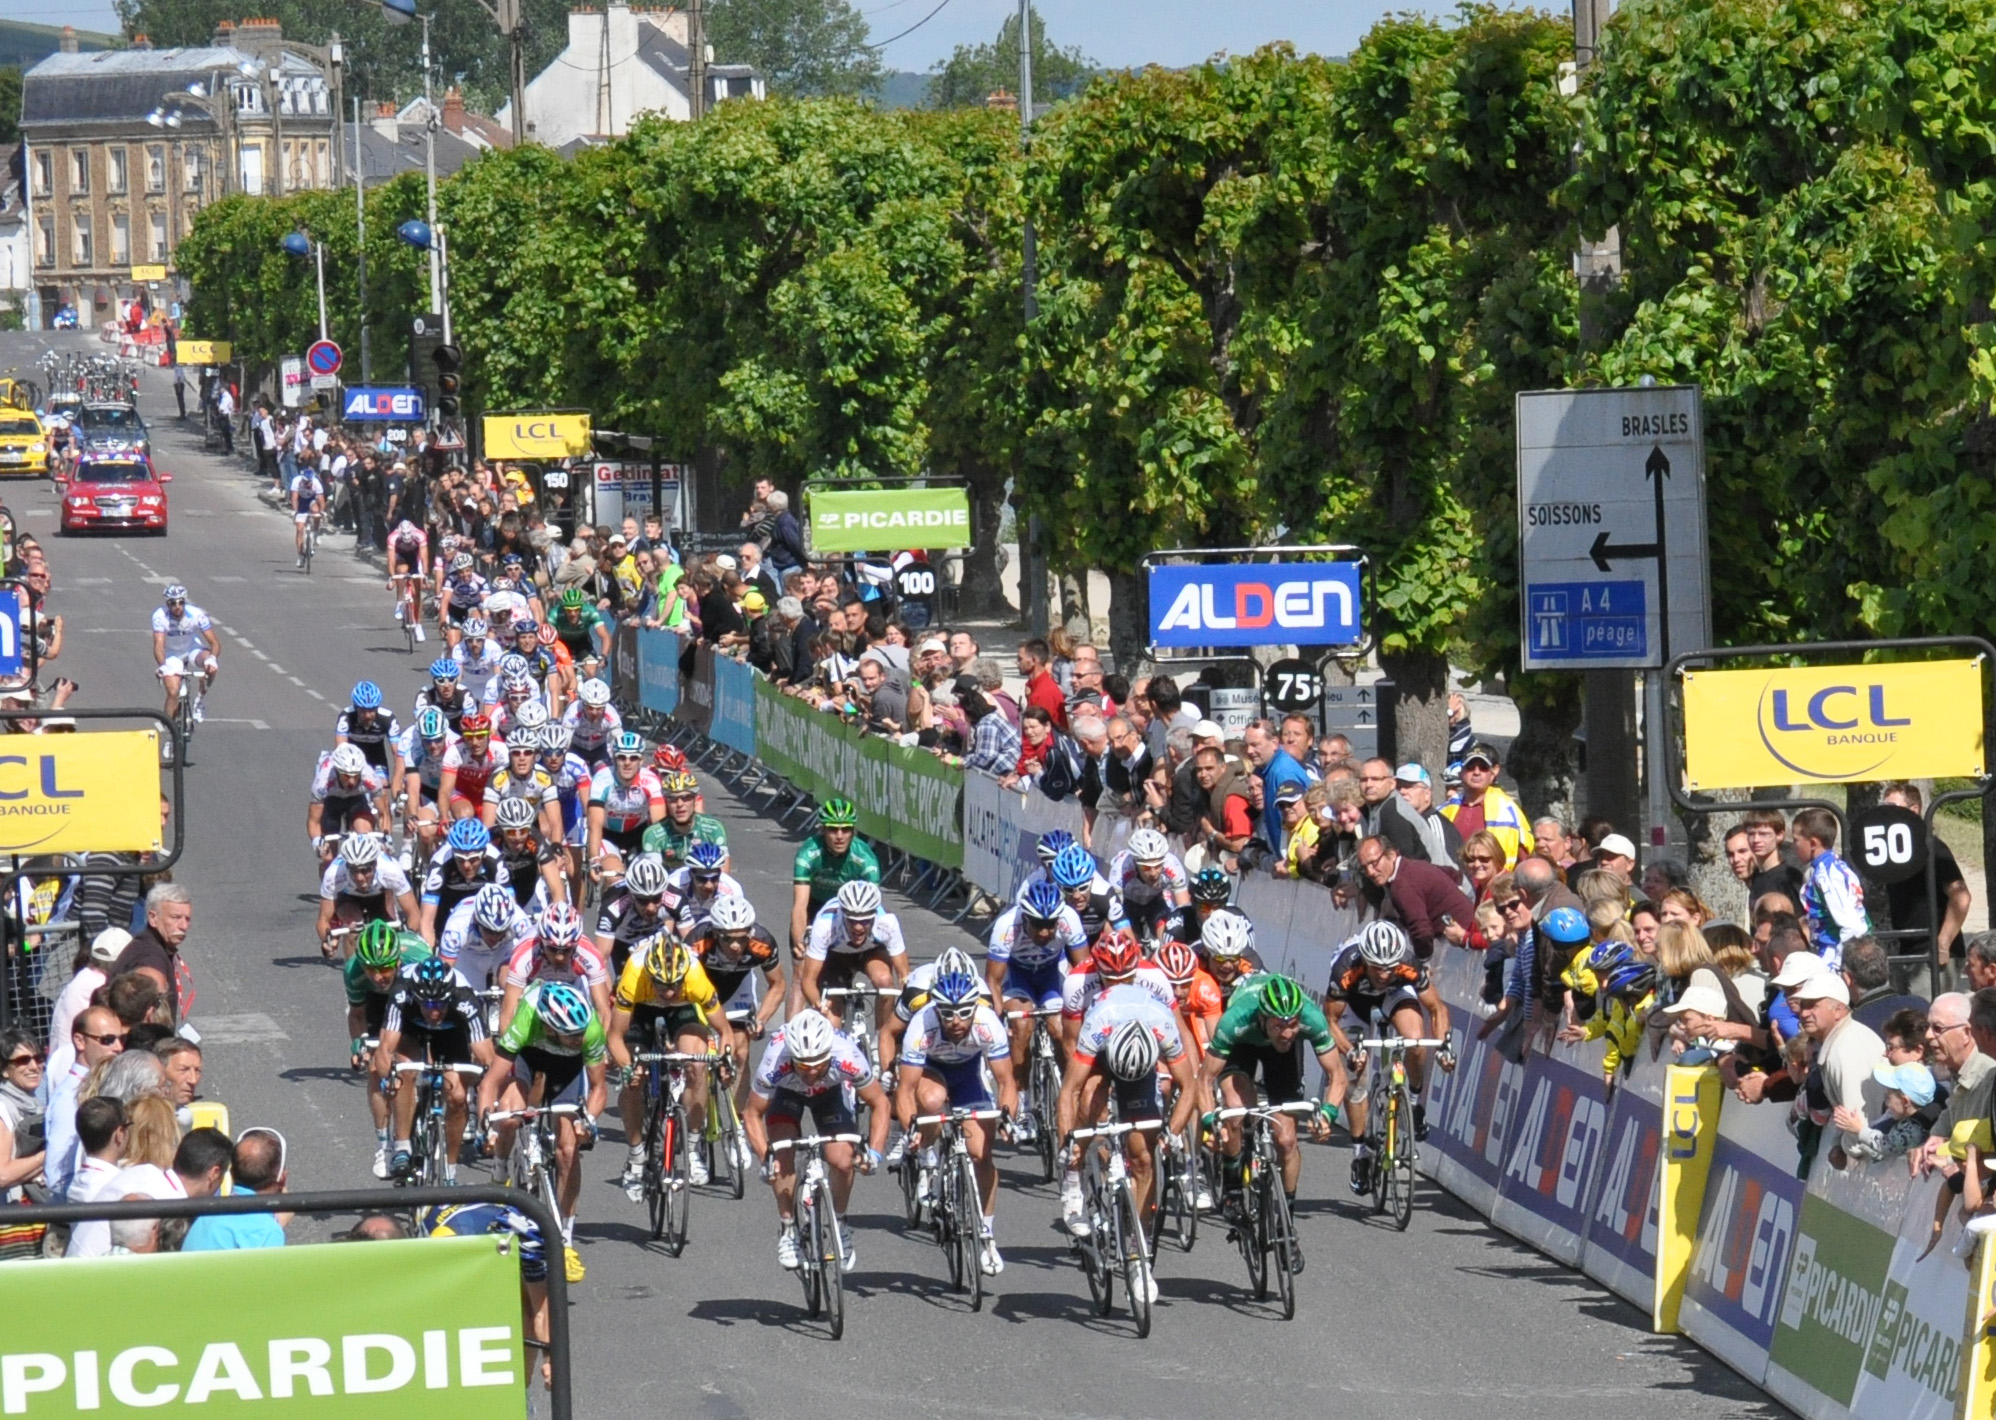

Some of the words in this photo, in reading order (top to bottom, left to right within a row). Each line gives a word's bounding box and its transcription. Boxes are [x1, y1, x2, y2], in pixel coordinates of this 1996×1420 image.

[346, 393, 424, 414] ALDEN
[386, 428, 408, 442] 200
[515, 422, 564, 439] LCL
[1622, 413, 1688, 437] BRASLES
[543, 472, 569, 488] 150
[844, 509, 967, 529] PICARDIE
[1528, 503, 1602, 527] SOISSONS
[899, 571, 934, 595] 100
[1157, 580, 1353, 630] ALDEN
[1581, 587, 1592, 612] A
[1599, 587, 1611, 612] 4
[1586, 621, 1635, 646] péage
[1232, 693, 1261, 704] Musé
[1277, 673, 1311, 701] 75
[1772, 684, 1911, 732] LCL
[1826, 732, 1898, 745] BANQUE
[0, 754, 85, 800] CL
[1863, 823, 1913, 866] 50
[1672, 1080, 1700, 1160] LCL
[1505, 1075, 1606, 1214] ALDEN
[1691, 1163, 1794, 1327] ALDEN
[1, 1326, 515, 1416] PICARDIE
